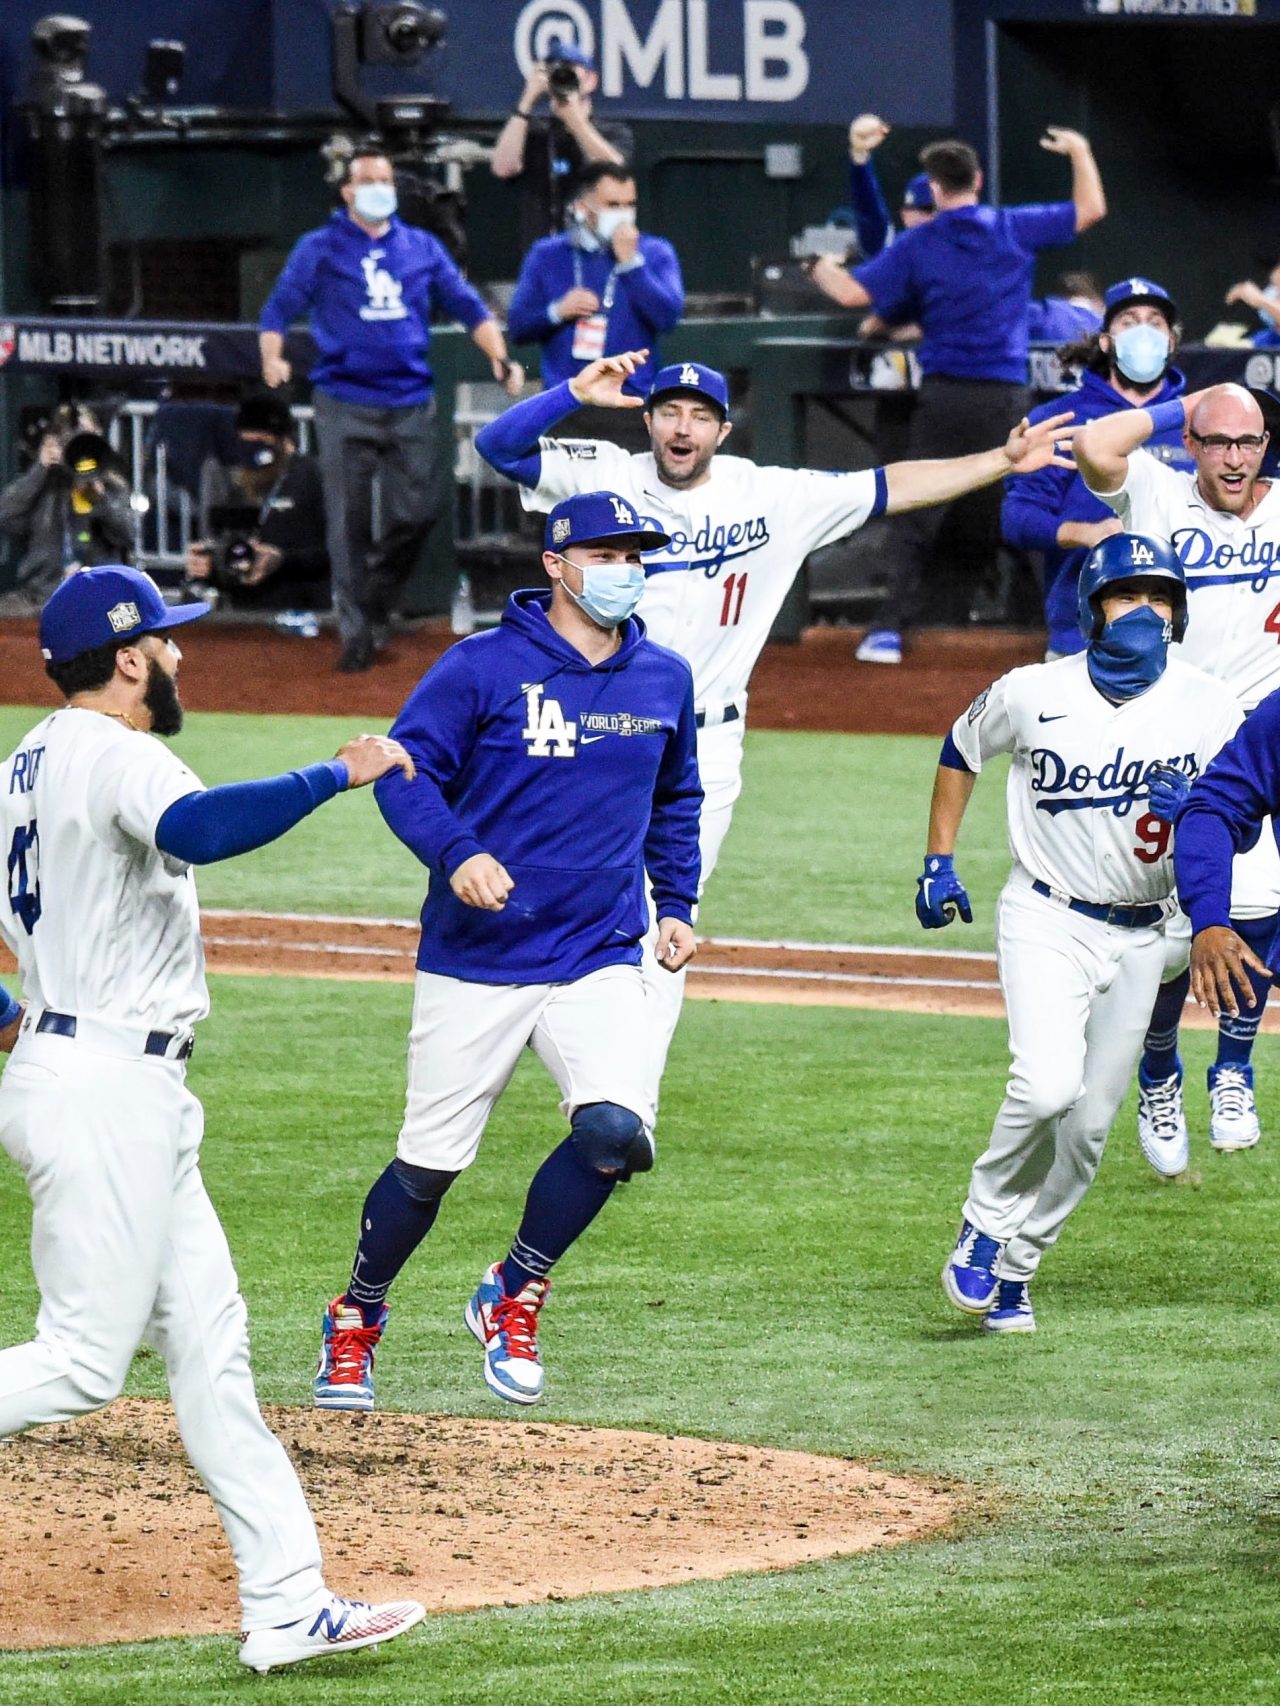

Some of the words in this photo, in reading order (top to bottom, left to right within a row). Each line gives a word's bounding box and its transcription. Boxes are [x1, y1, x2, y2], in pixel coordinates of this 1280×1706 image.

[514, 0, 810, 101] @MLB
[19, 332, 73, 363] MLB
[75, 334, 206, 367] NETWORK
[679, 363, 699, 386] LA
[609, 497, 634, 525] LA
[1130, 539, 1154, 566] LA
[720, 572, 748, 626] 11
[521, 683, 577, 758] LA
[580, 714, 618, 730] WORLD
[1134, 812, 1174, 864] 9
